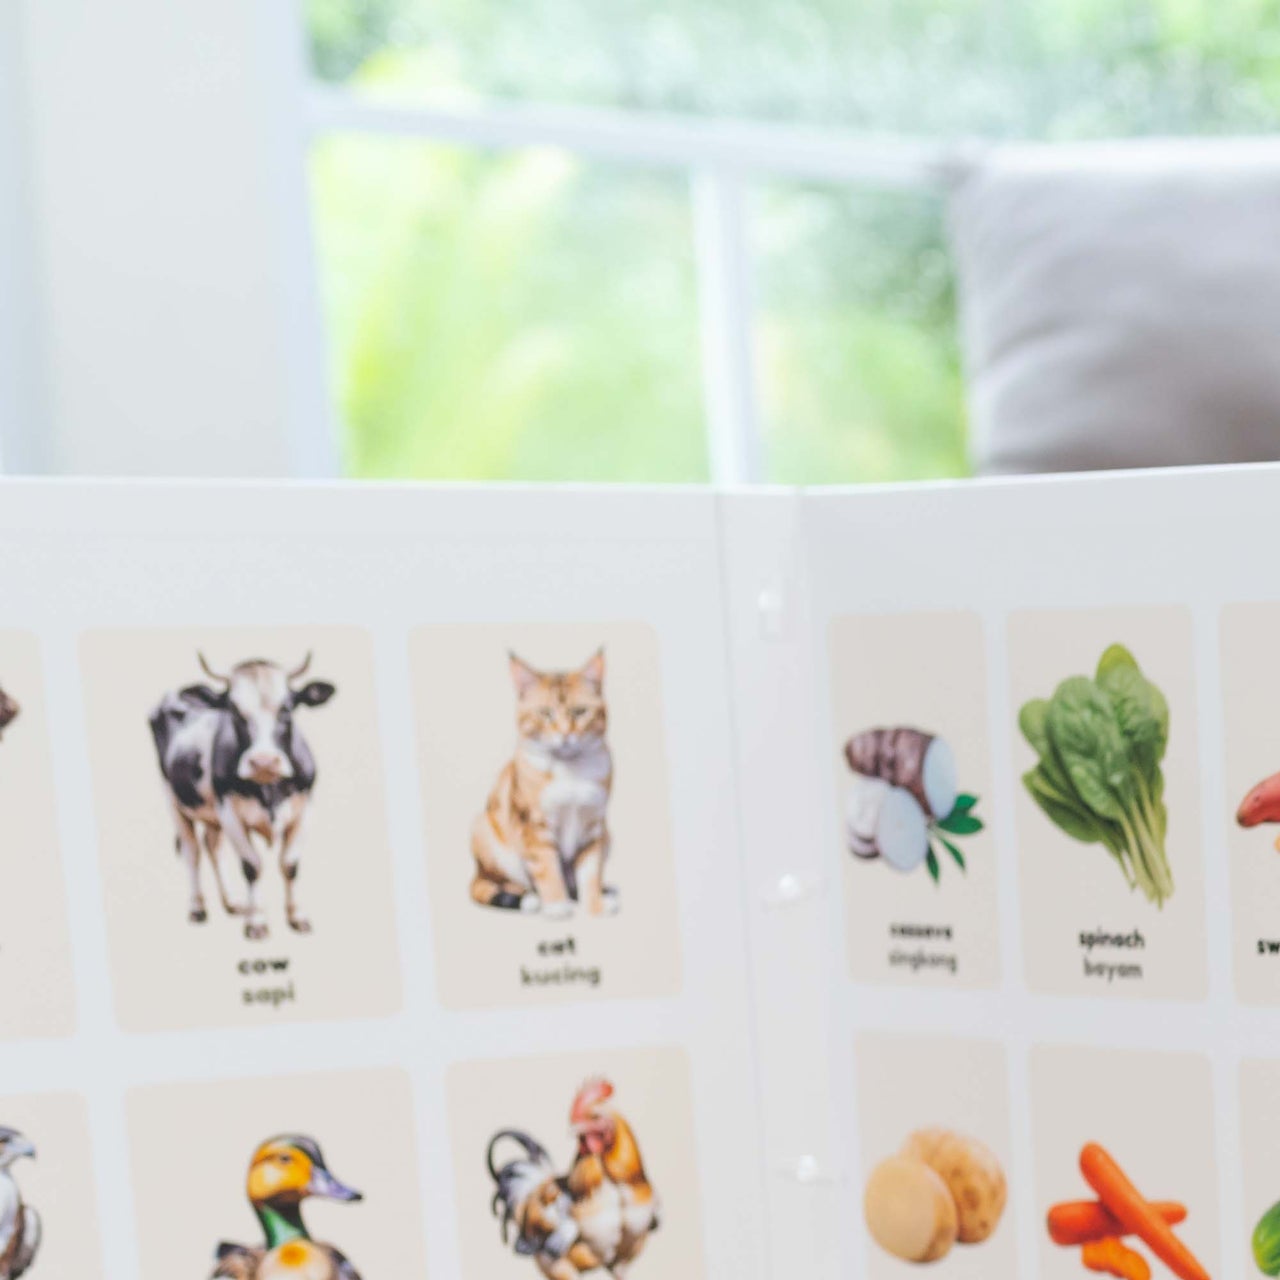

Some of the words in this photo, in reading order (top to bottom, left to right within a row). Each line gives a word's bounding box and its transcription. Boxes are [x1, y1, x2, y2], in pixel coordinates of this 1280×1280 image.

[537, 936, 576, 957] cat
[1078, 928, 1146, 952] spinach
[237, 959, 290, 975] cow
[519, 965, 602, 988] kucing
[1082, 956, 1143, 983] bayam
[241, 982, 296, 1008] sapi
